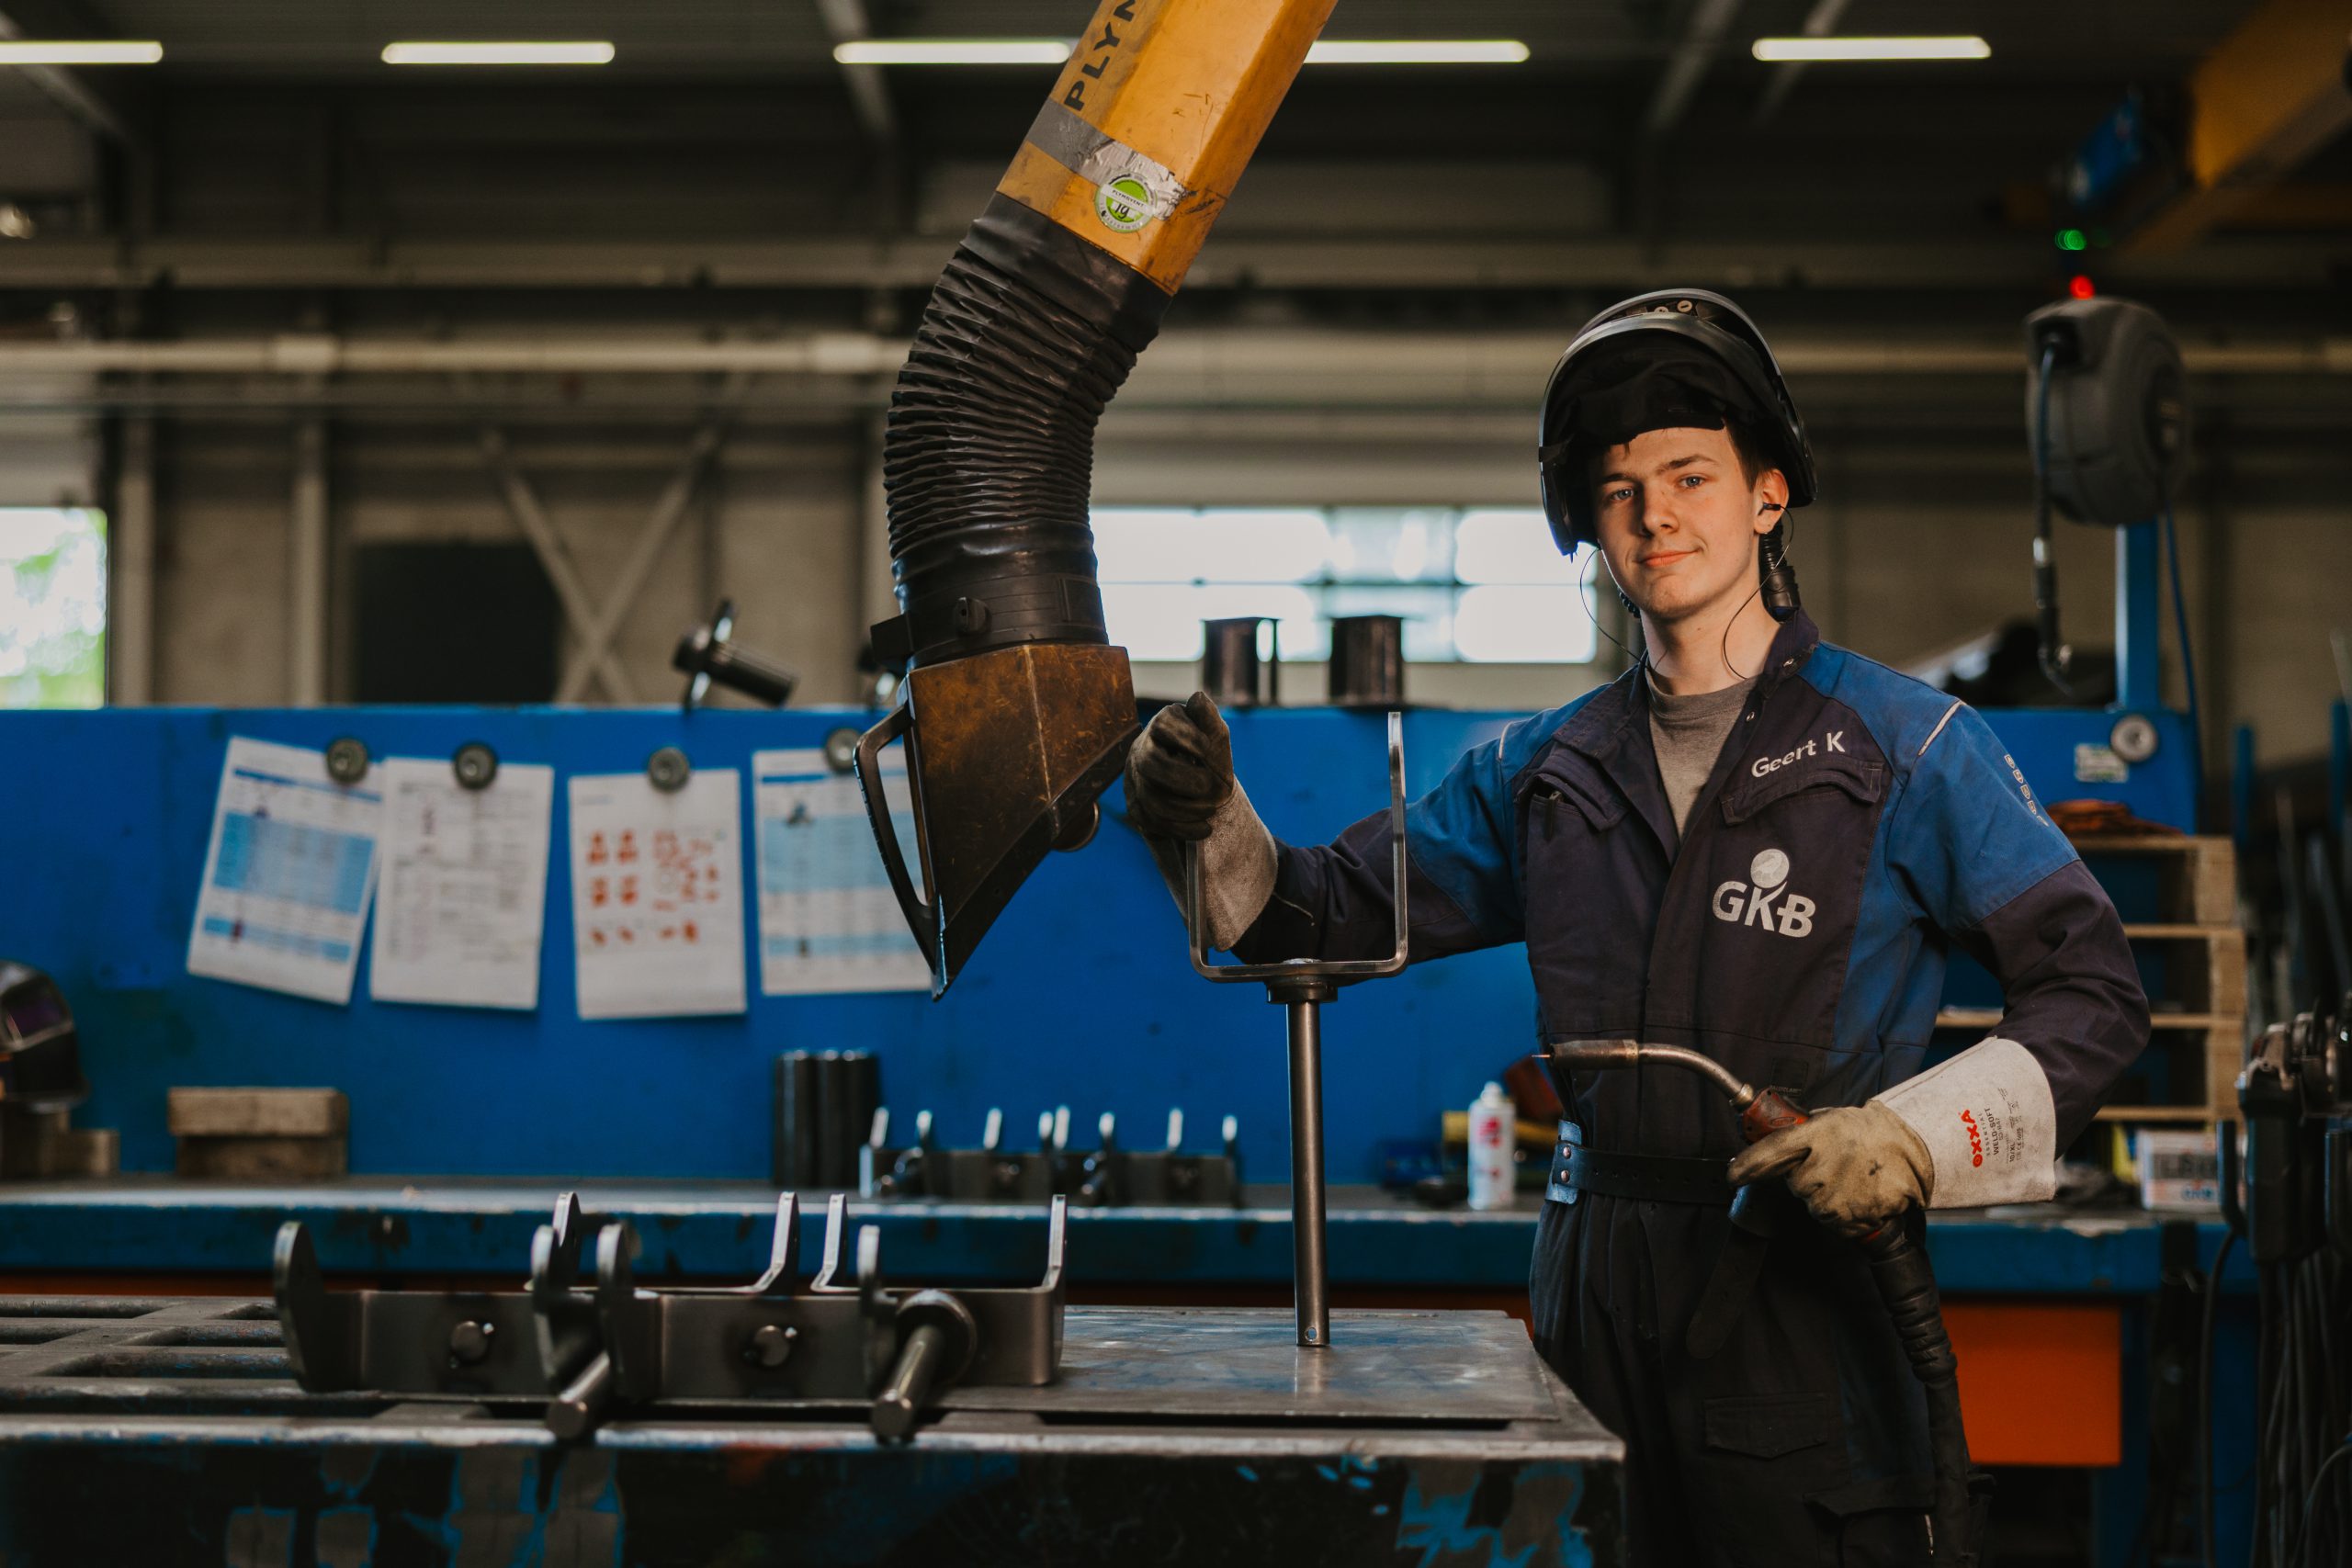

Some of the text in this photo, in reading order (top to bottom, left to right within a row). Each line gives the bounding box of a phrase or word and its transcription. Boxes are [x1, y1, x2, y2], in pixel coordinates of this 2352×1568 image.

[1751, 730, 1846, 777] Geert K
[1712, 880, 1816, 938] GKB
[1961, 1110, 1983, 1168] OXXA
[1978, 1112, 1990, 1156] ESSENTIAL
[1984, 1107, 2000, 1156] WELD-SOFT
